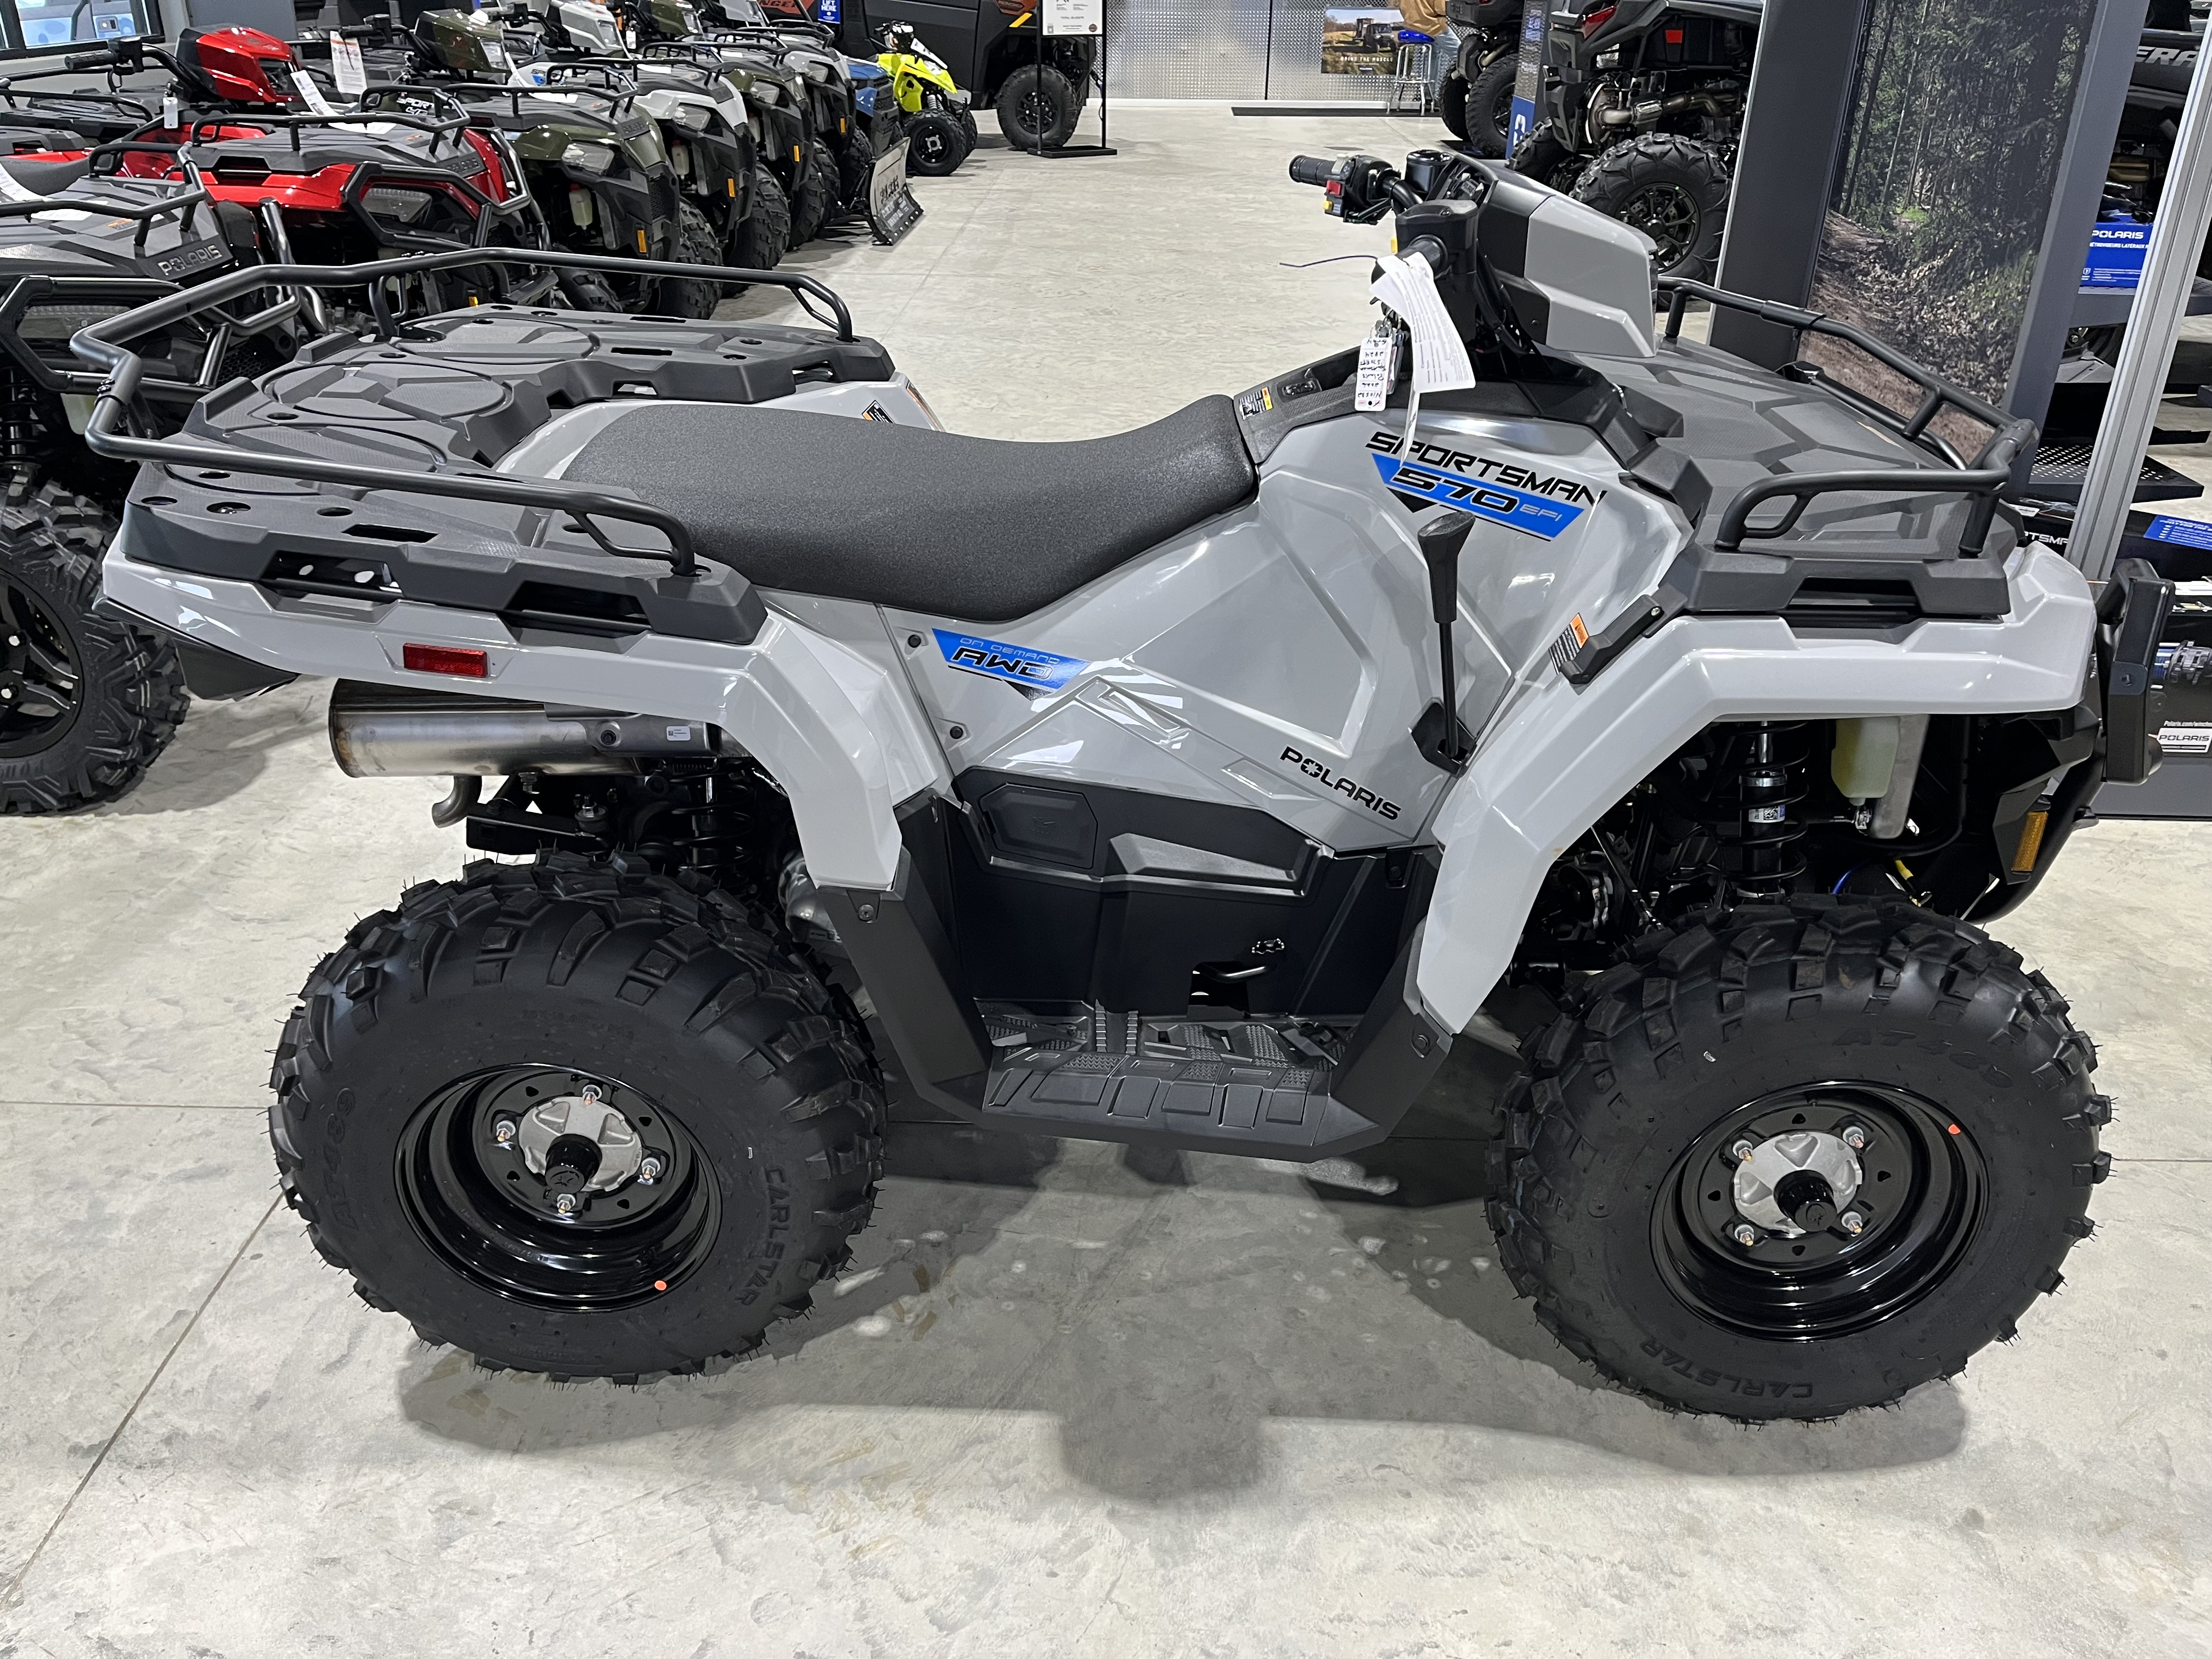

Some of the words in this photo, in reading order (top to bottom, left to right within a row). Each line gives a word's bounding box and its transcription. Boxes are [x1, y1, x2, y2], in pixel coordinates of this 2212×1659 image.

[157, 245, 223, 275] POLARIS
[2091, 230, 2144, 239] POLARIS
[1365, 431, 1608, 507] SPORTSMAN
[1391, 467, 1519, 514] 570
[1519, 504, 1563, 522] EFI
[951, 647, 1053, 680] AWD
[960, 637, 984, 647] ON
[991, 645, 1060, 665] DEMAND
[1280, 746, 1402, 821] POLARIS
[733, 1167, 791, 1305] CARLSTAR
[1640, 1336, 1813, 1398] CARLSTAR
